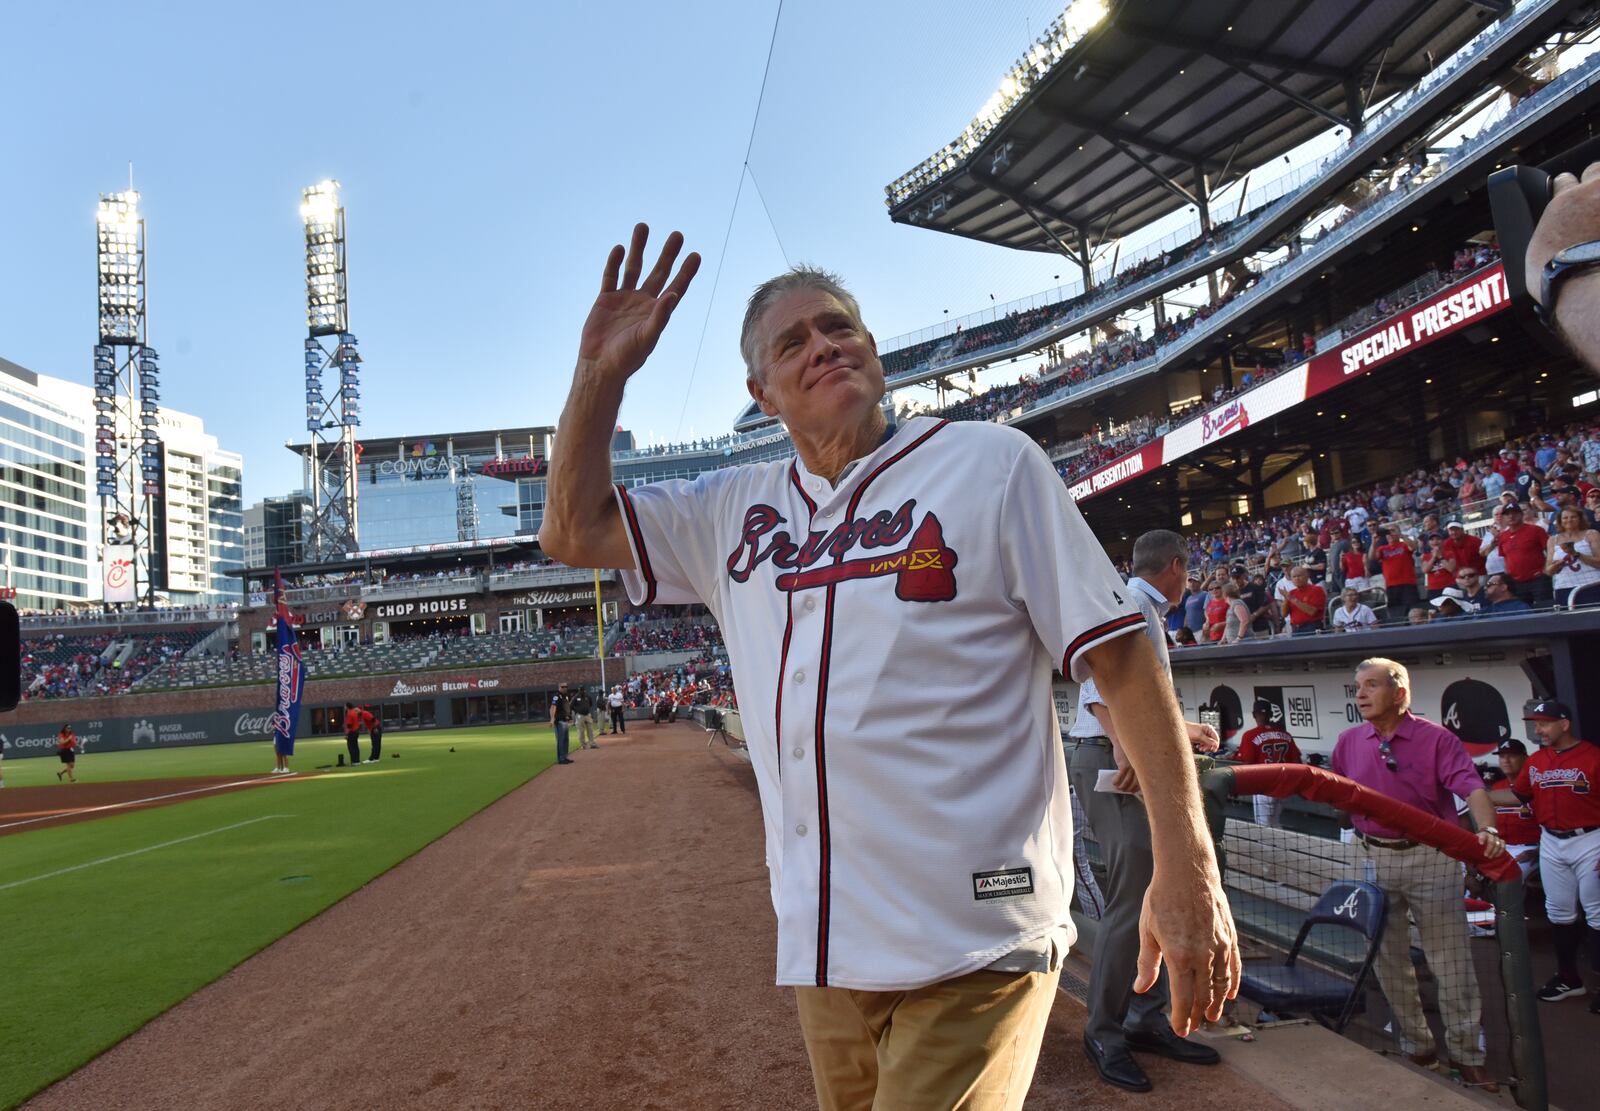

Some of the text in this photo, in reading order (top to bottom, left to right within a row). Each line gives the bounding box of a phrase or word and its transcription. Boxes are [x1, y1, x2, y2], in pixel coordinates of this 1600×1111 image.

[1341, 322, 1411, 375] SPECIAL
[1202, 400, 1239, 443] Braves
[732, 435, 785, 453] KONICA MINOLTA
[380, 455, 470, 475] COMCAST
[481, 455, 544, 476] xfinity
[1069, 453, 1143, 500] SPECIAL PRESENTATION
[726, 498, 917, 584] Braves
[513, 596, 526, 605] THE
[527, 591, 571, 605] Silver
[305, 611, 339, 623] LIGHT
[376, 599, 467, 617] CHOP HOUSE
[416, 685, 437, 694] LIGHT
[1288, 697, 1312, 712] NEW
[159, 724, 182, 732] KAISER
[1290, 713, 1313, 727] ERA
[1262, 742, 1288, 764] 37
[992, 875, 1027, 888] Majestic
[1334, 888, 1358, 918] A
